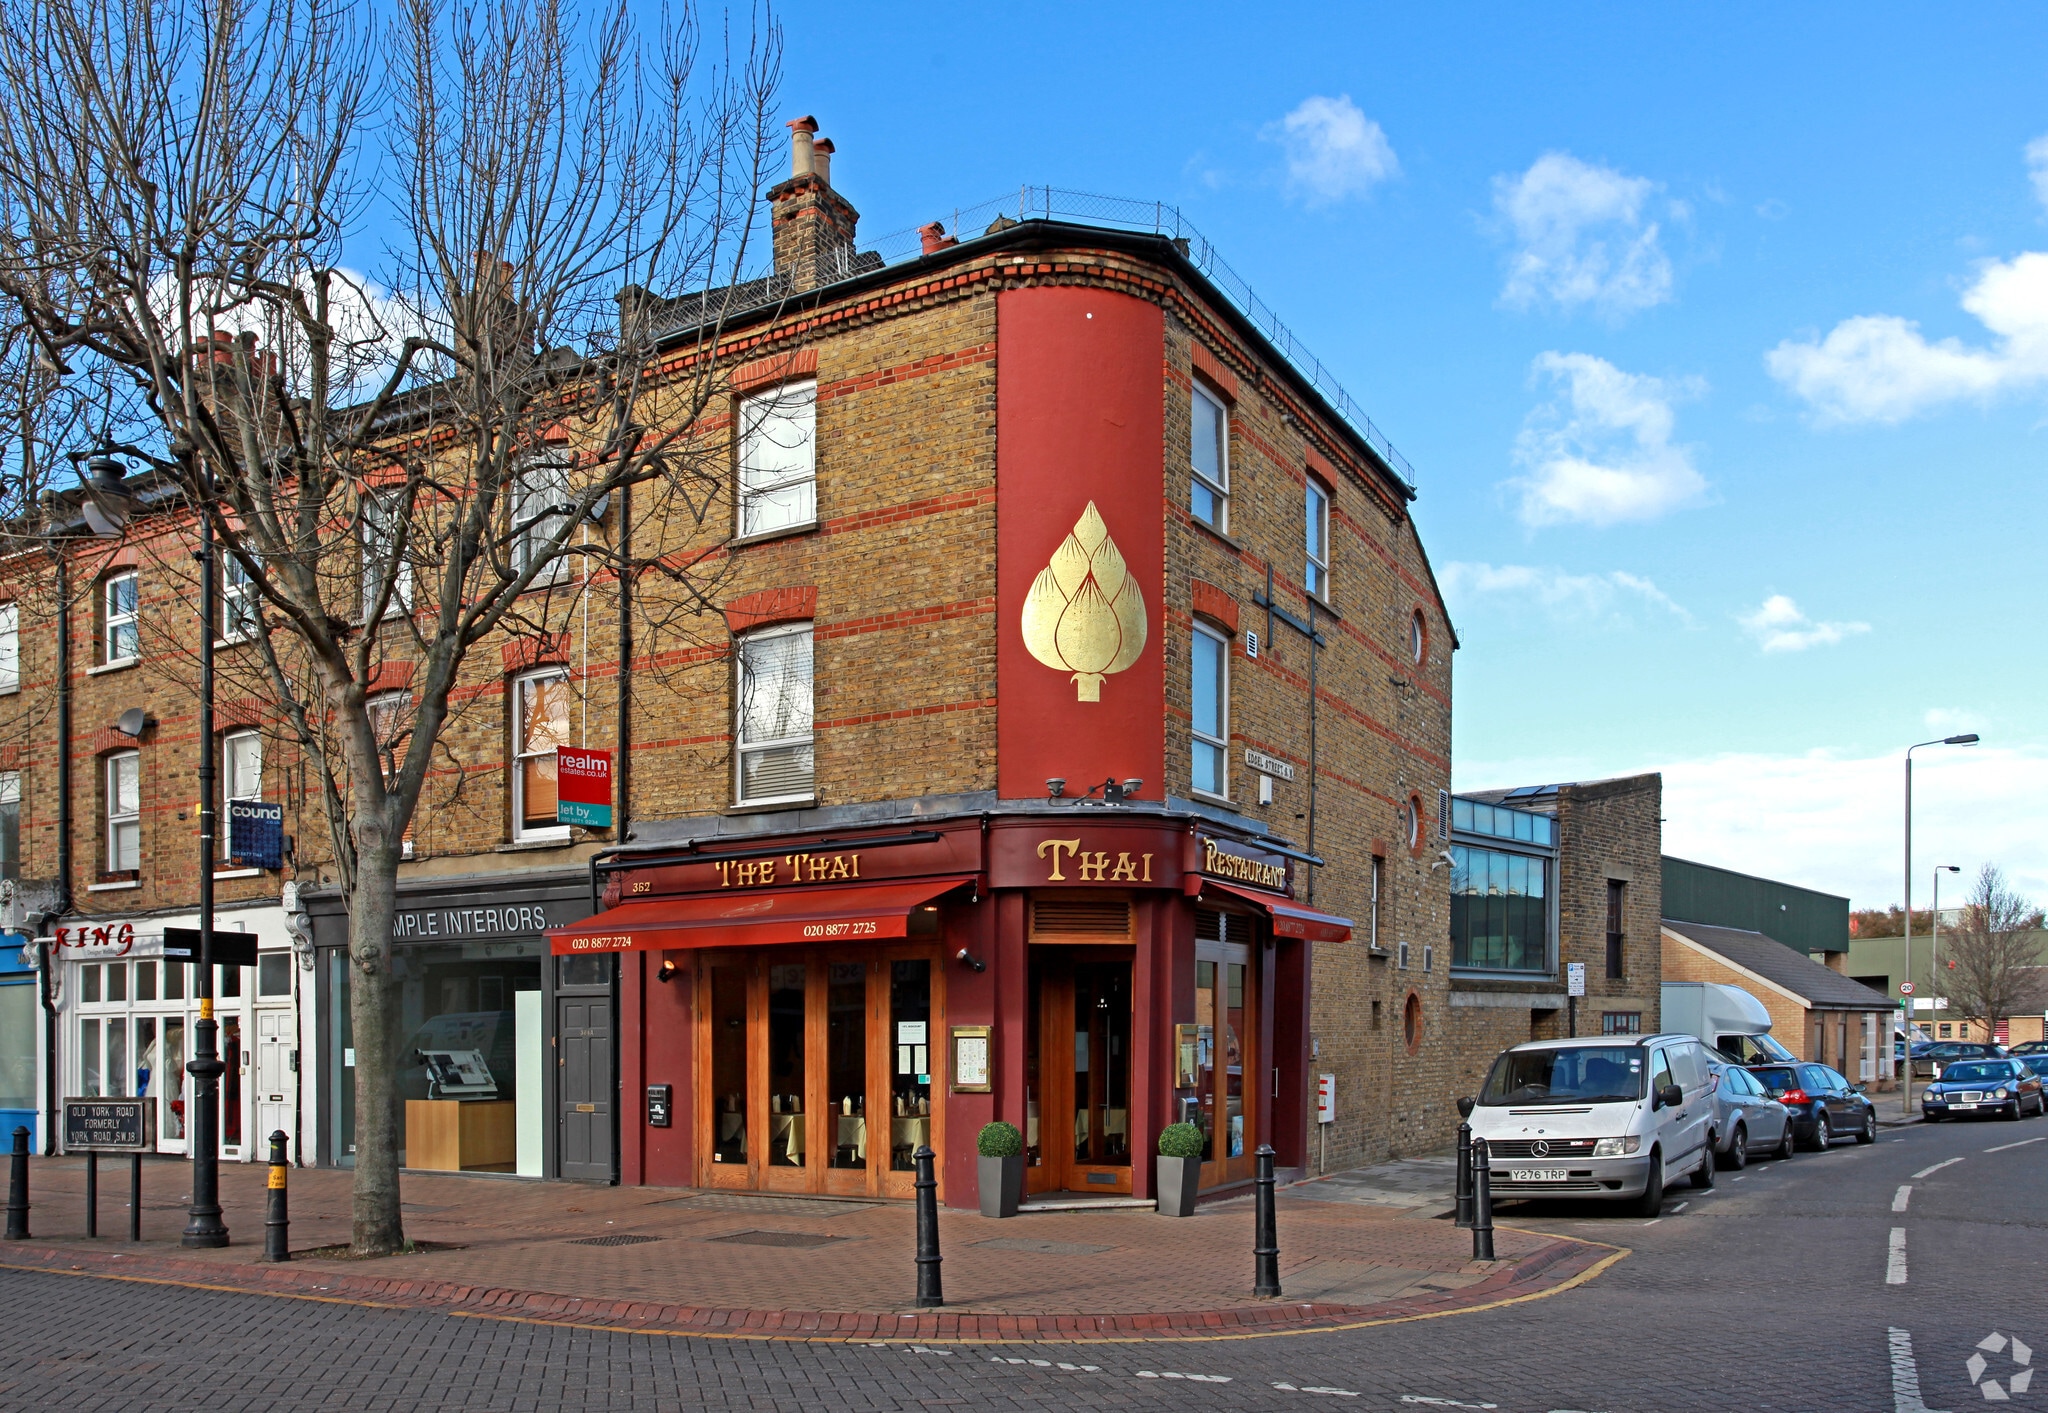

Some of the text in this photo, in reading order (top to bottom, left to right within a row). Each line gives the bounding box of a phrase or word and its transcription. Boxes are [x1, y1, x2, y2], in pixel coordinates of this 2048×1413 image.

[560, 754, 608, 771] realm
[1265, 759, 1283, 775] STREET
[560, 767, 607, 778] estates.co.uk
[232, 806, 281, 820] cound
[560, 804, 590, 819] let by
[1037, 838, 1154, 882] THAI
[1203, 836, 1286, 888] RESTAURANT
[715, 853, 861, 887] THE THAI
[632, 881, 650, 893] 362
[393, 913, 439, 936] MPLE
[803, 921, 876, 937] 020 8877 2725
[52, 924, 134, 956] RING
[572, 936, 632, 949] 020 8877 2724
[72, 1106, 134, 1117] OLD YORK ROAD
[84, 1119, 120, 1129] FORMERLY
[71, 1131, 88, 1142] YORK
[93, 1131, 111, 1141] ROAD
[1513, 1170, 1566, 1179] Y276 TRP
